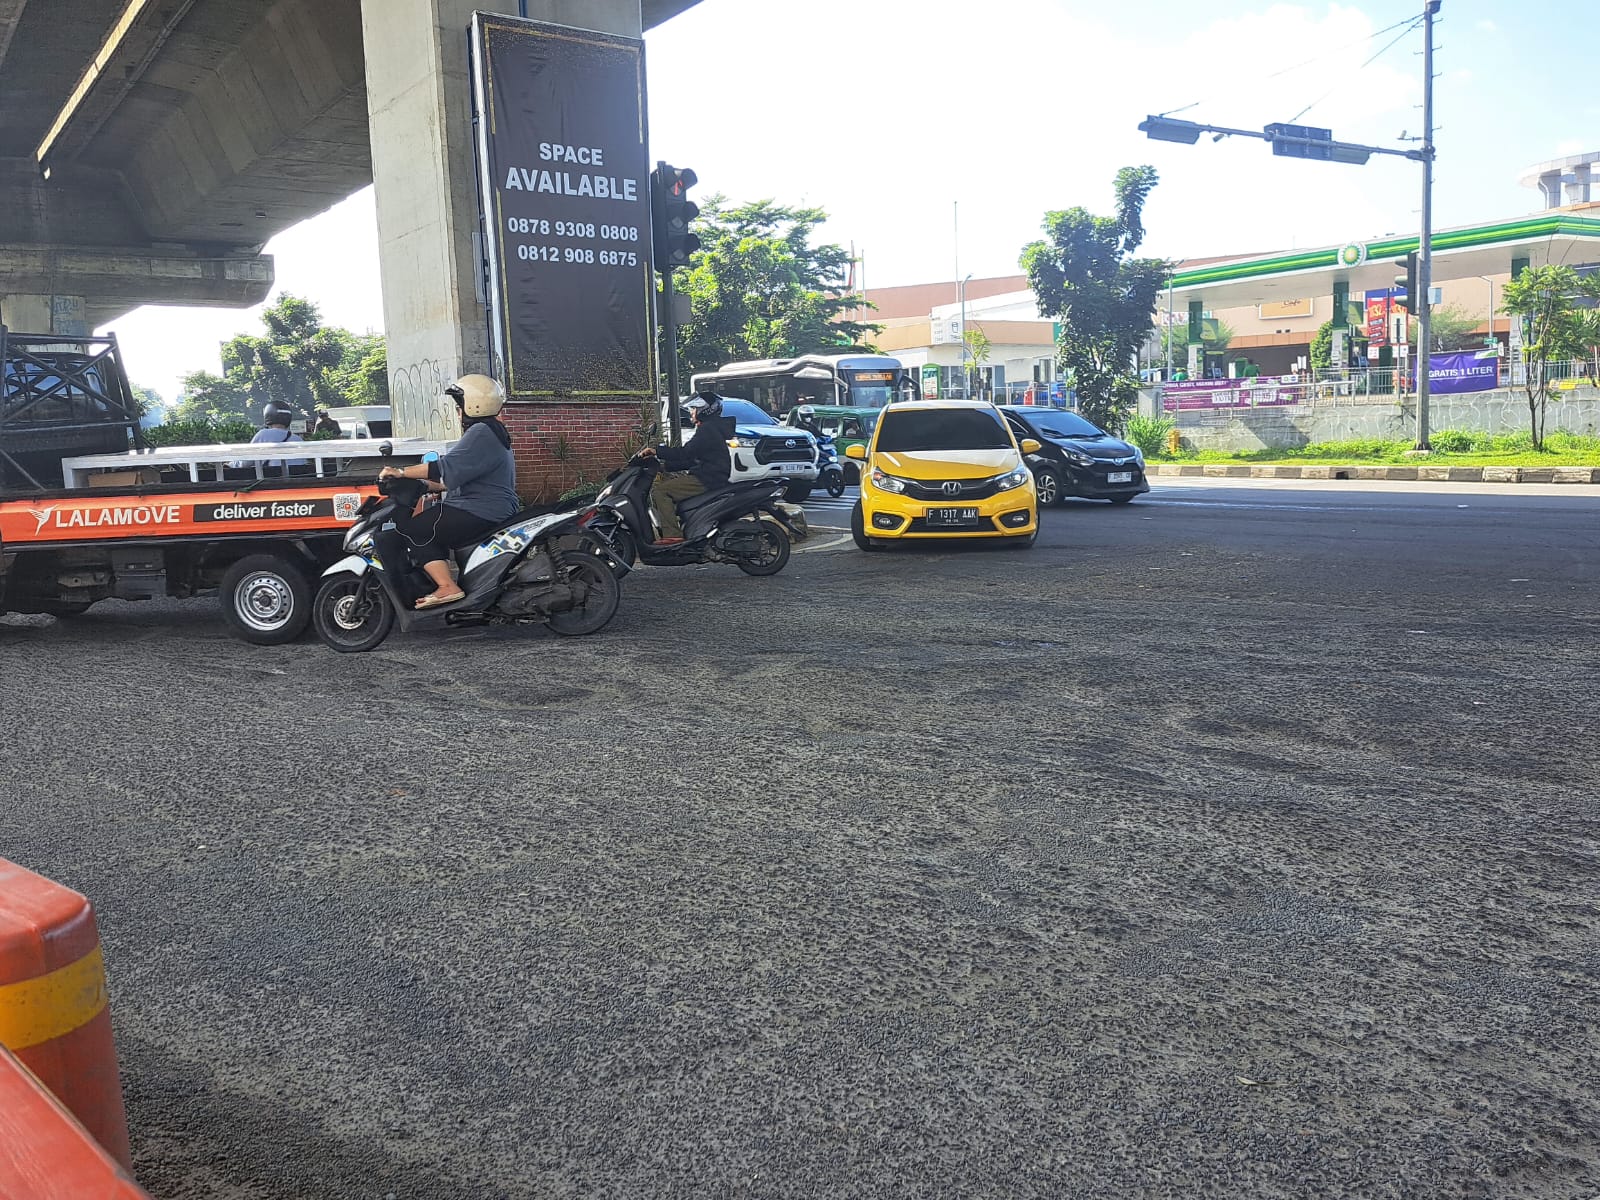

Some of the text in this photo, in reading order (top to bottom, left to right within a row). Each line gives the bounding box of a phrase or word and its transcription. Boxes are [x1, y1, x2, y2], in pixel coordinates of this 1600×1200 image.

[539, 142, 604, 166] SPACE
[505, 167, 638, 201] AVAILABLE
[507, 217, 638, 241] 0878 9308 0808
[517, 244, 637, 267] 0812 908 6875
[1428, 366, 1493, 378] GRATIS 1 LITER
[56, 505, 181, 528] LALAMOVE
[213, 502, 315, 519] deliver faster
[928, 509, 935, 519] F
[940, 509, 957, 519] 1317
